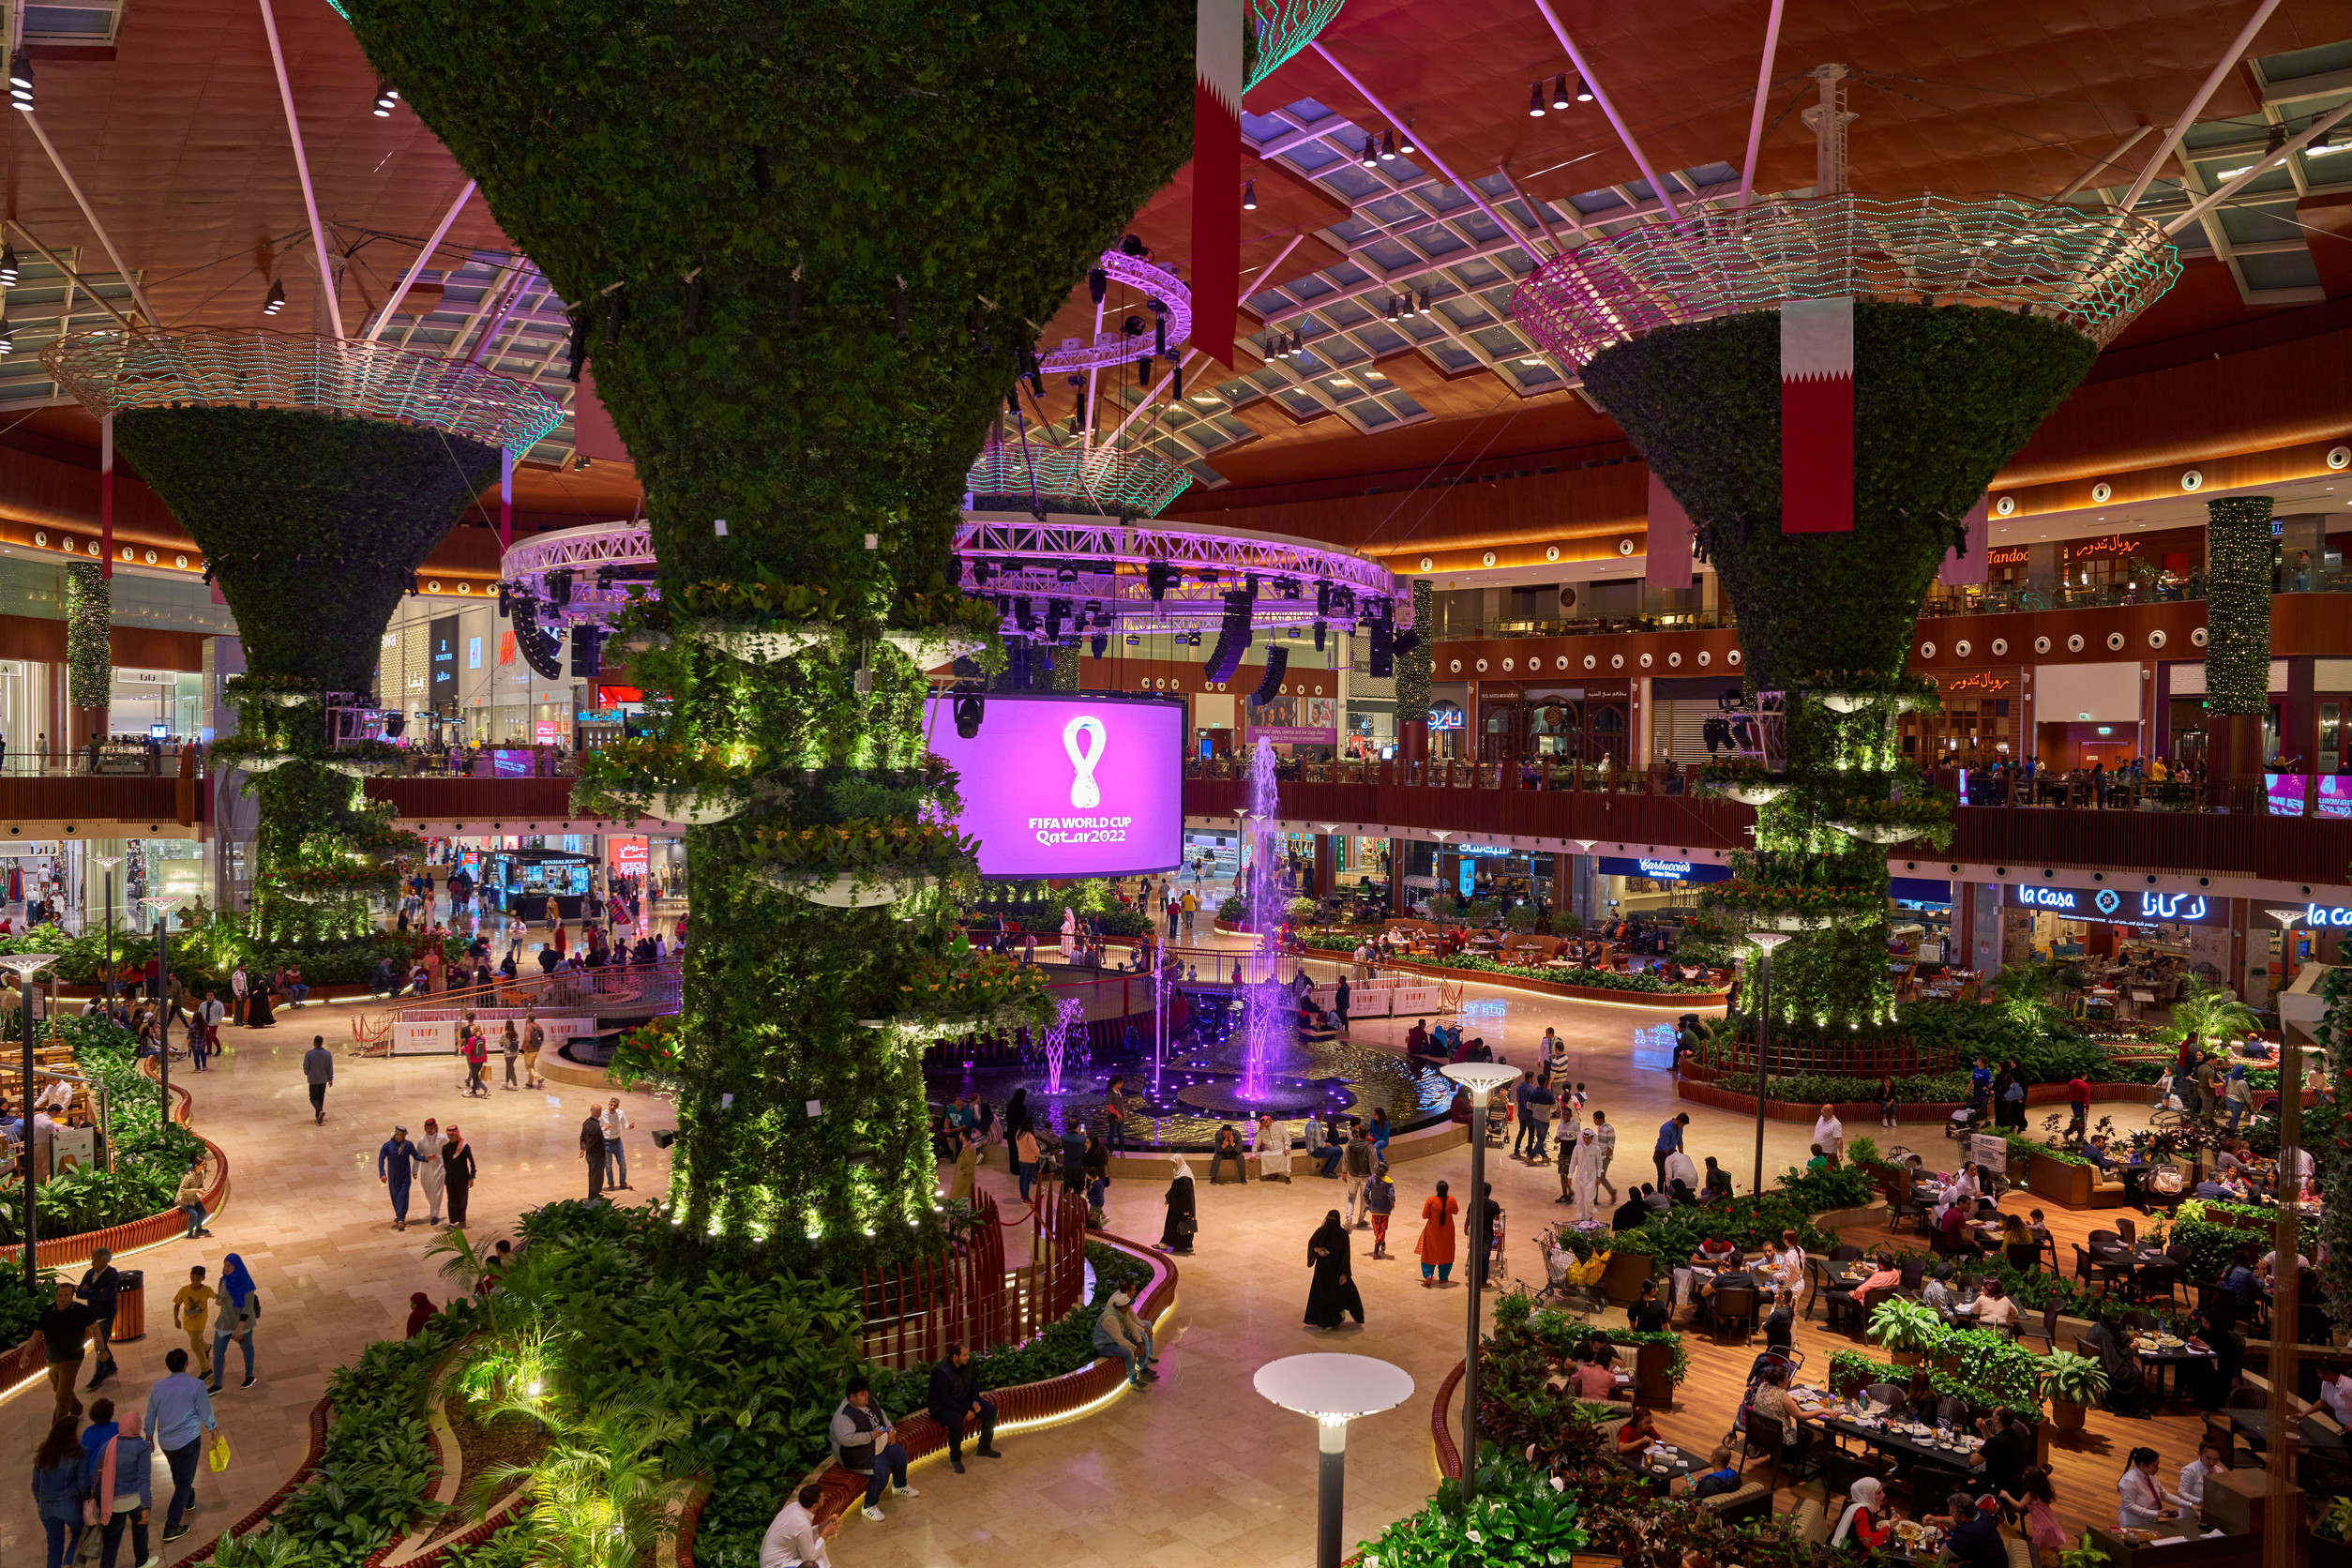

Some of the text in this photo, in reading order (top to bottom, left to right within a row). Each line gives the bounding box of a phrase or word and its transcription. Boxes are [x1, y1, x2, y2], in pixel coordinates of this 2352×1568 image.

[1988, 548, 2028, 565] Tandoo
[1029, 816, 1132, 829] FIFA WORLD CUP
[1639, 858, 1691, 873] Carluccio's
